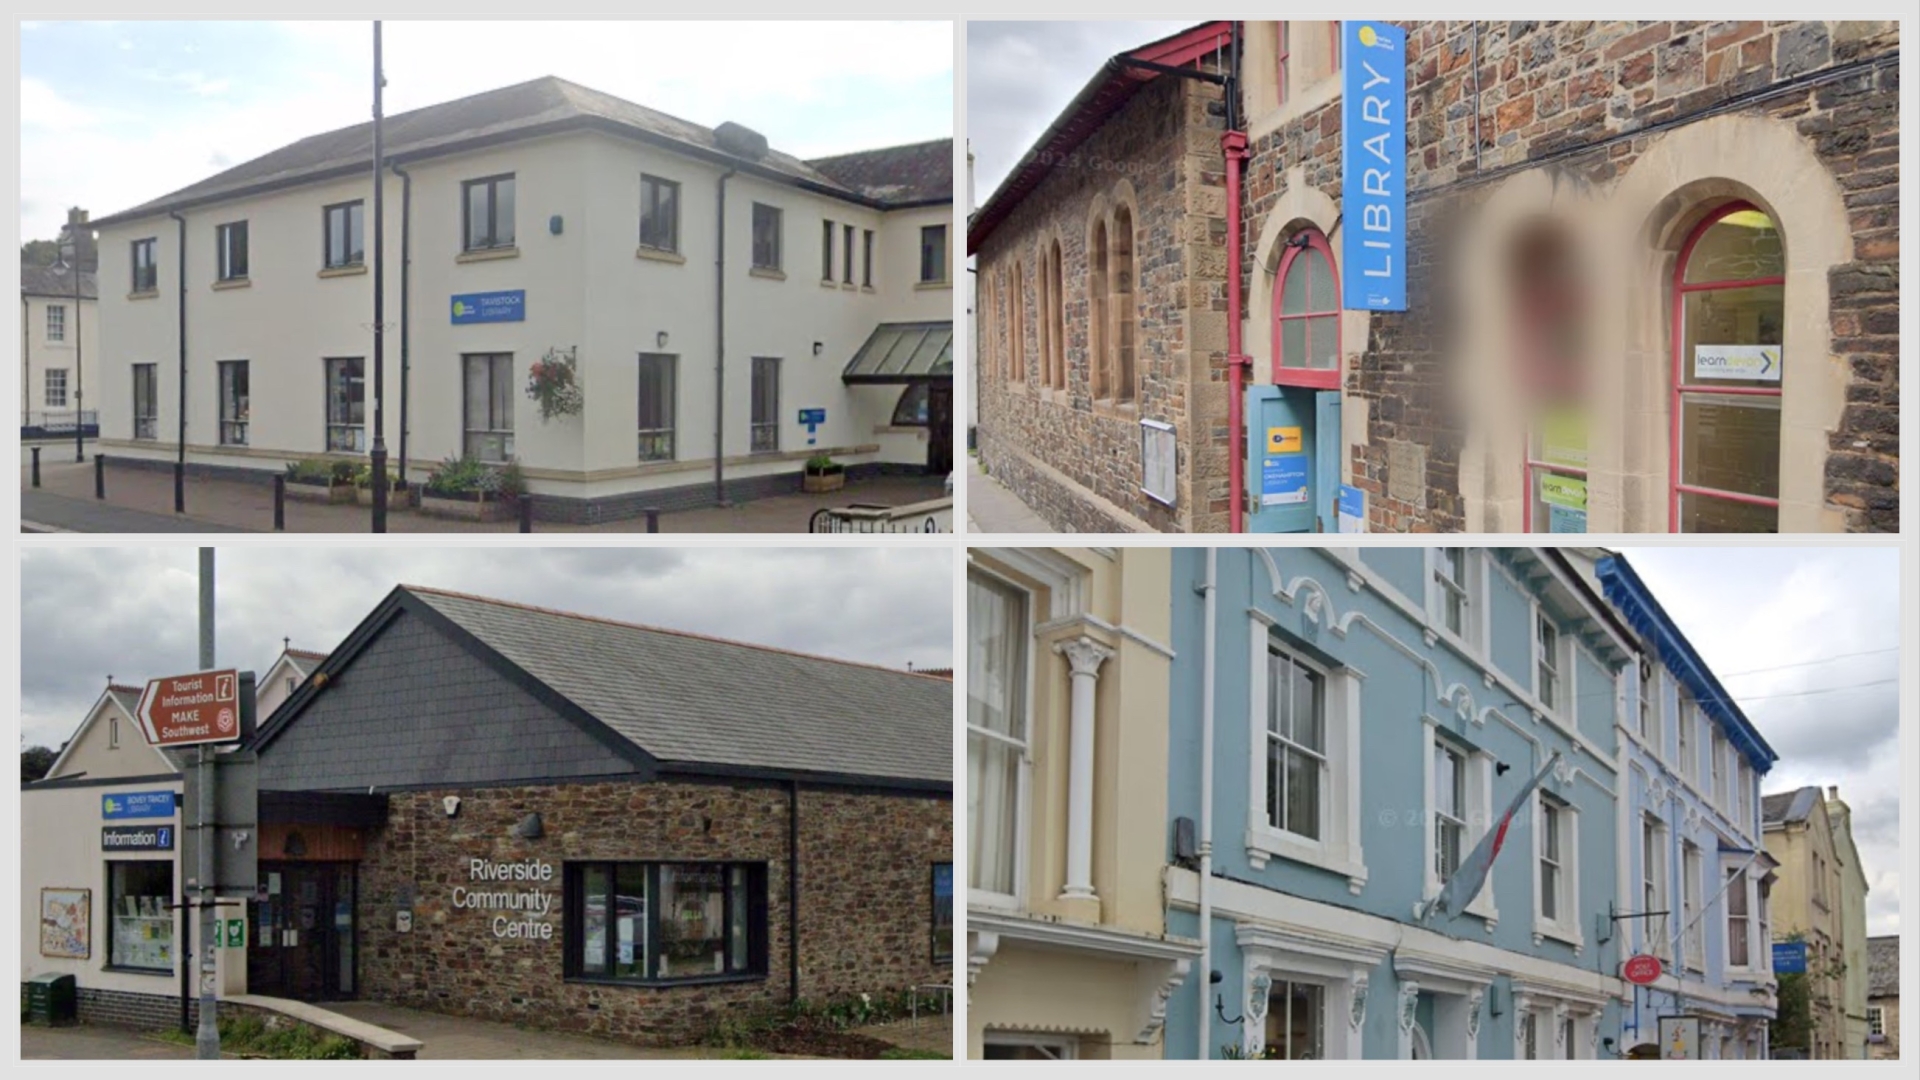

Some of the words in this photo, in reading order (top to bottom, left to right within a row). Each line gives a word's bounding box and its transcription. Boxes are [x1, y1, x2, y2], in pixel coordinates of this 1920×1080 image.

[1362, 60, 1392, 278] LIBRARY
[172, 679, 203, 692] Tourist
[162, 693, 214, 708] Information
[171, 710, 200, 723] MAKE
[162, 723, 210, 738] Southwest
[103, 830, 156, 846] Information
[470, 858, 552, 880] Riverside
[453, 886, 552, 916] Community
[493, 915, 552, 940] Centre
